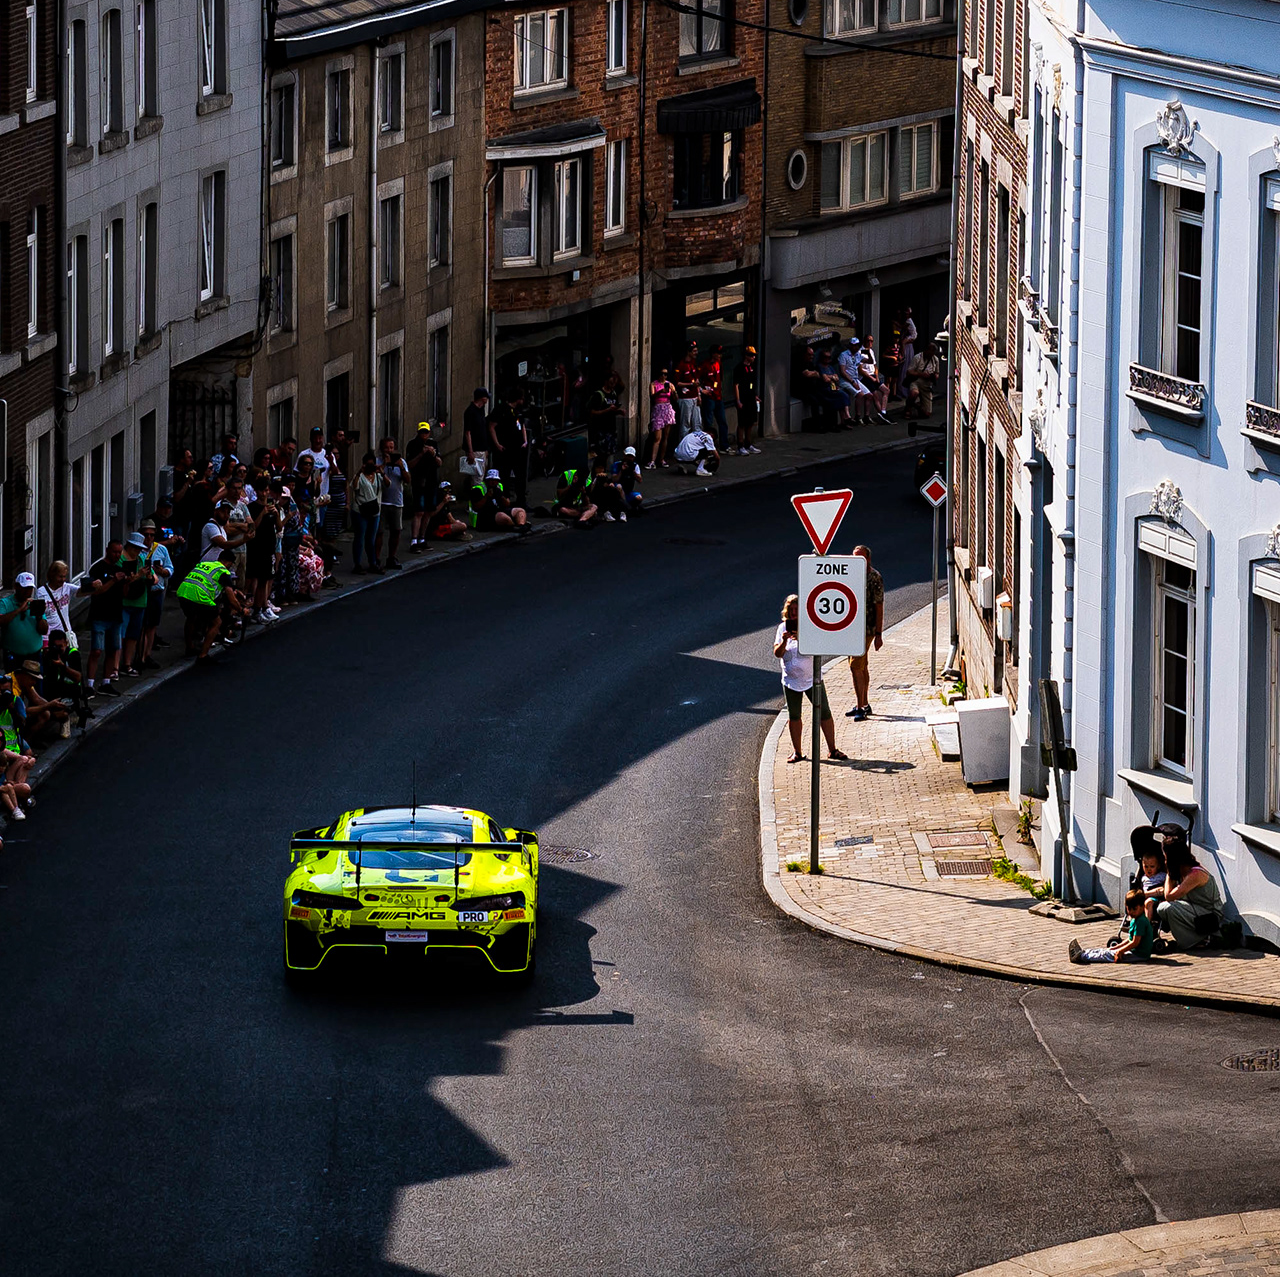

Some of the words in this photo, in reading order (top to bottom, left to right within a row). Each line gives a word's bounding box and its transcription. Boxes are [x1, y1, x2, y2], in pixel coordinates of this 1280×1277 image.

[816, 563, 849, 575] ZONE
[818, 597, 845, 615] 30
[393, 911, 446, 920] AMG
[463, 912, 484, 922] PRO
